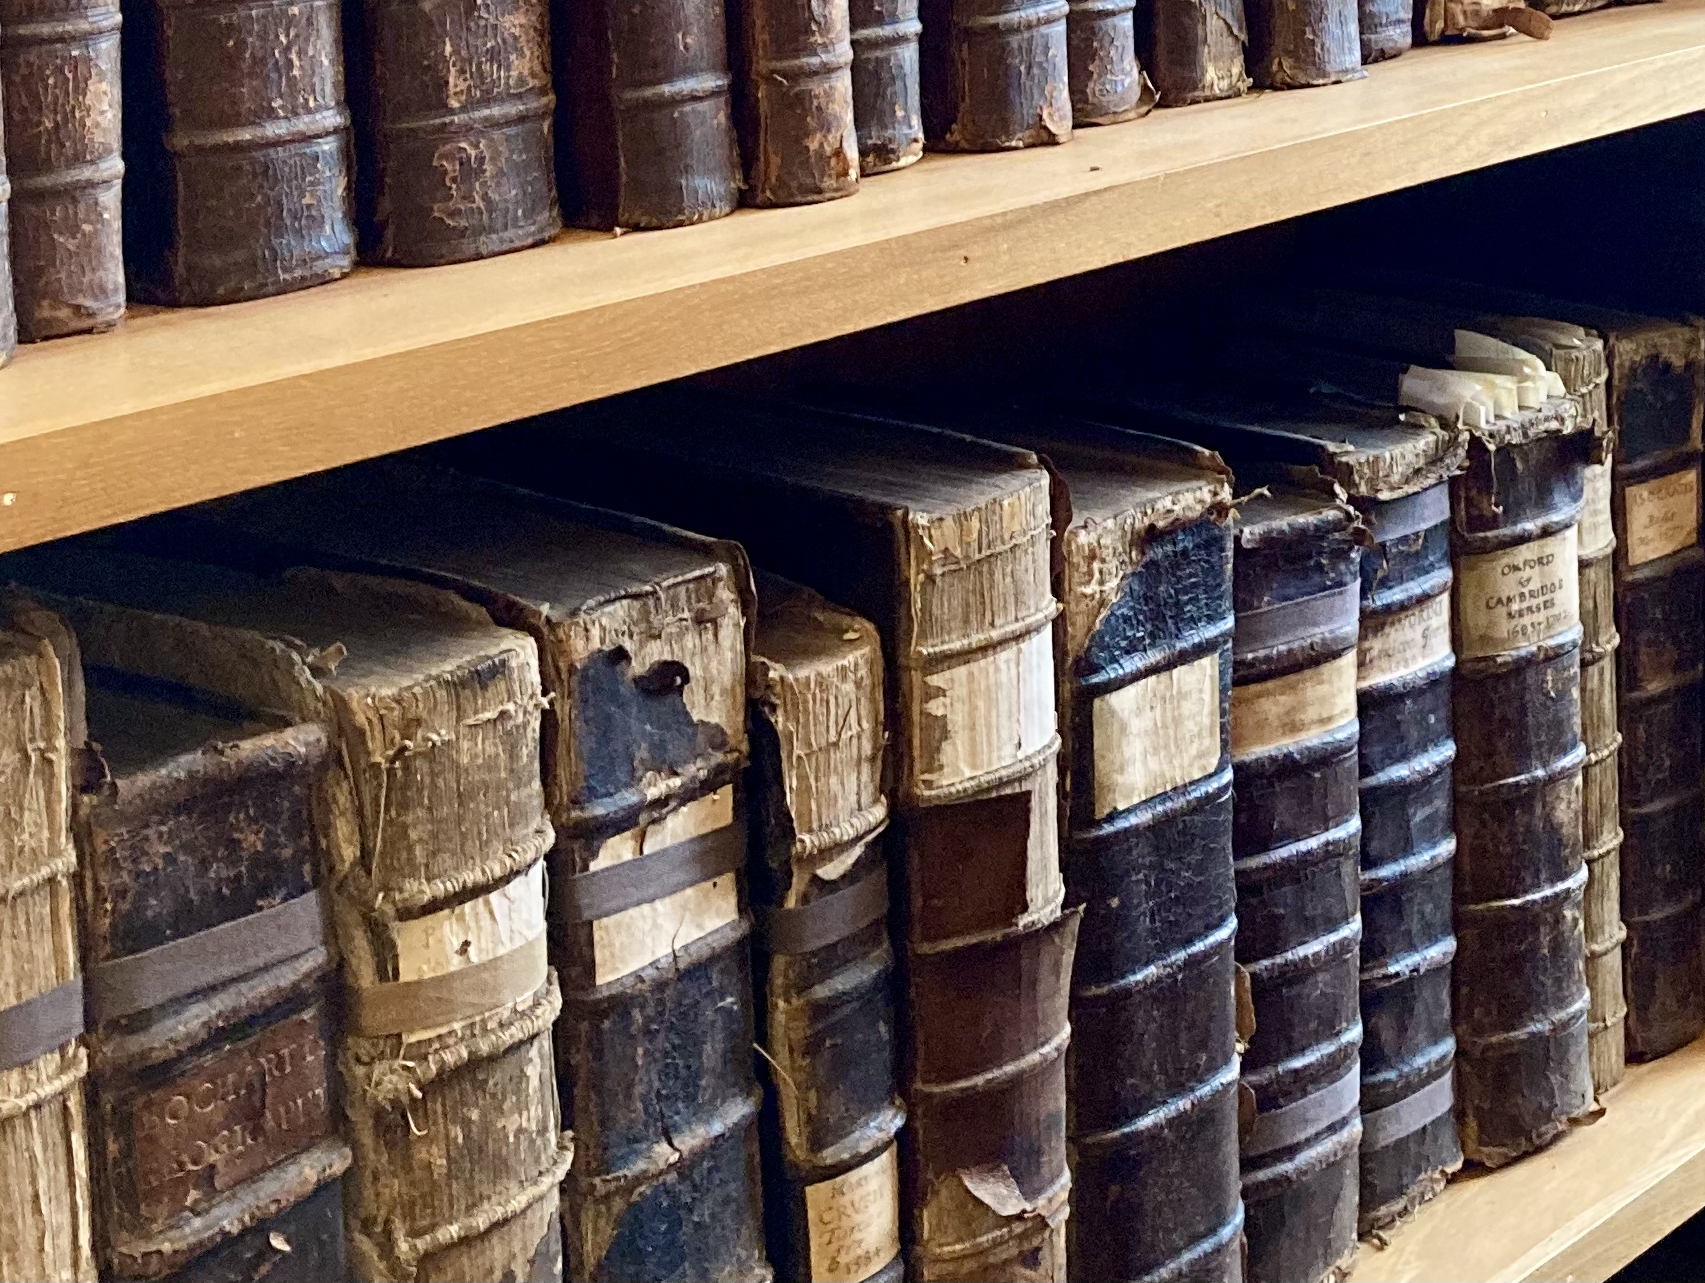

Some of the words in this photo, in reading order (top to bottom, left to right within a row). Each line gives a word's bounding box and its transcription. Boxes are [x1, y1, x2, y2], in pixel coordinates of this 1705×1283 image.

[1501, 553, 1555, 577] OXFORD
[1485, 578, 1564, 610] CAMBRIDGE
[1506, 597, 1556, 621] VERSES
